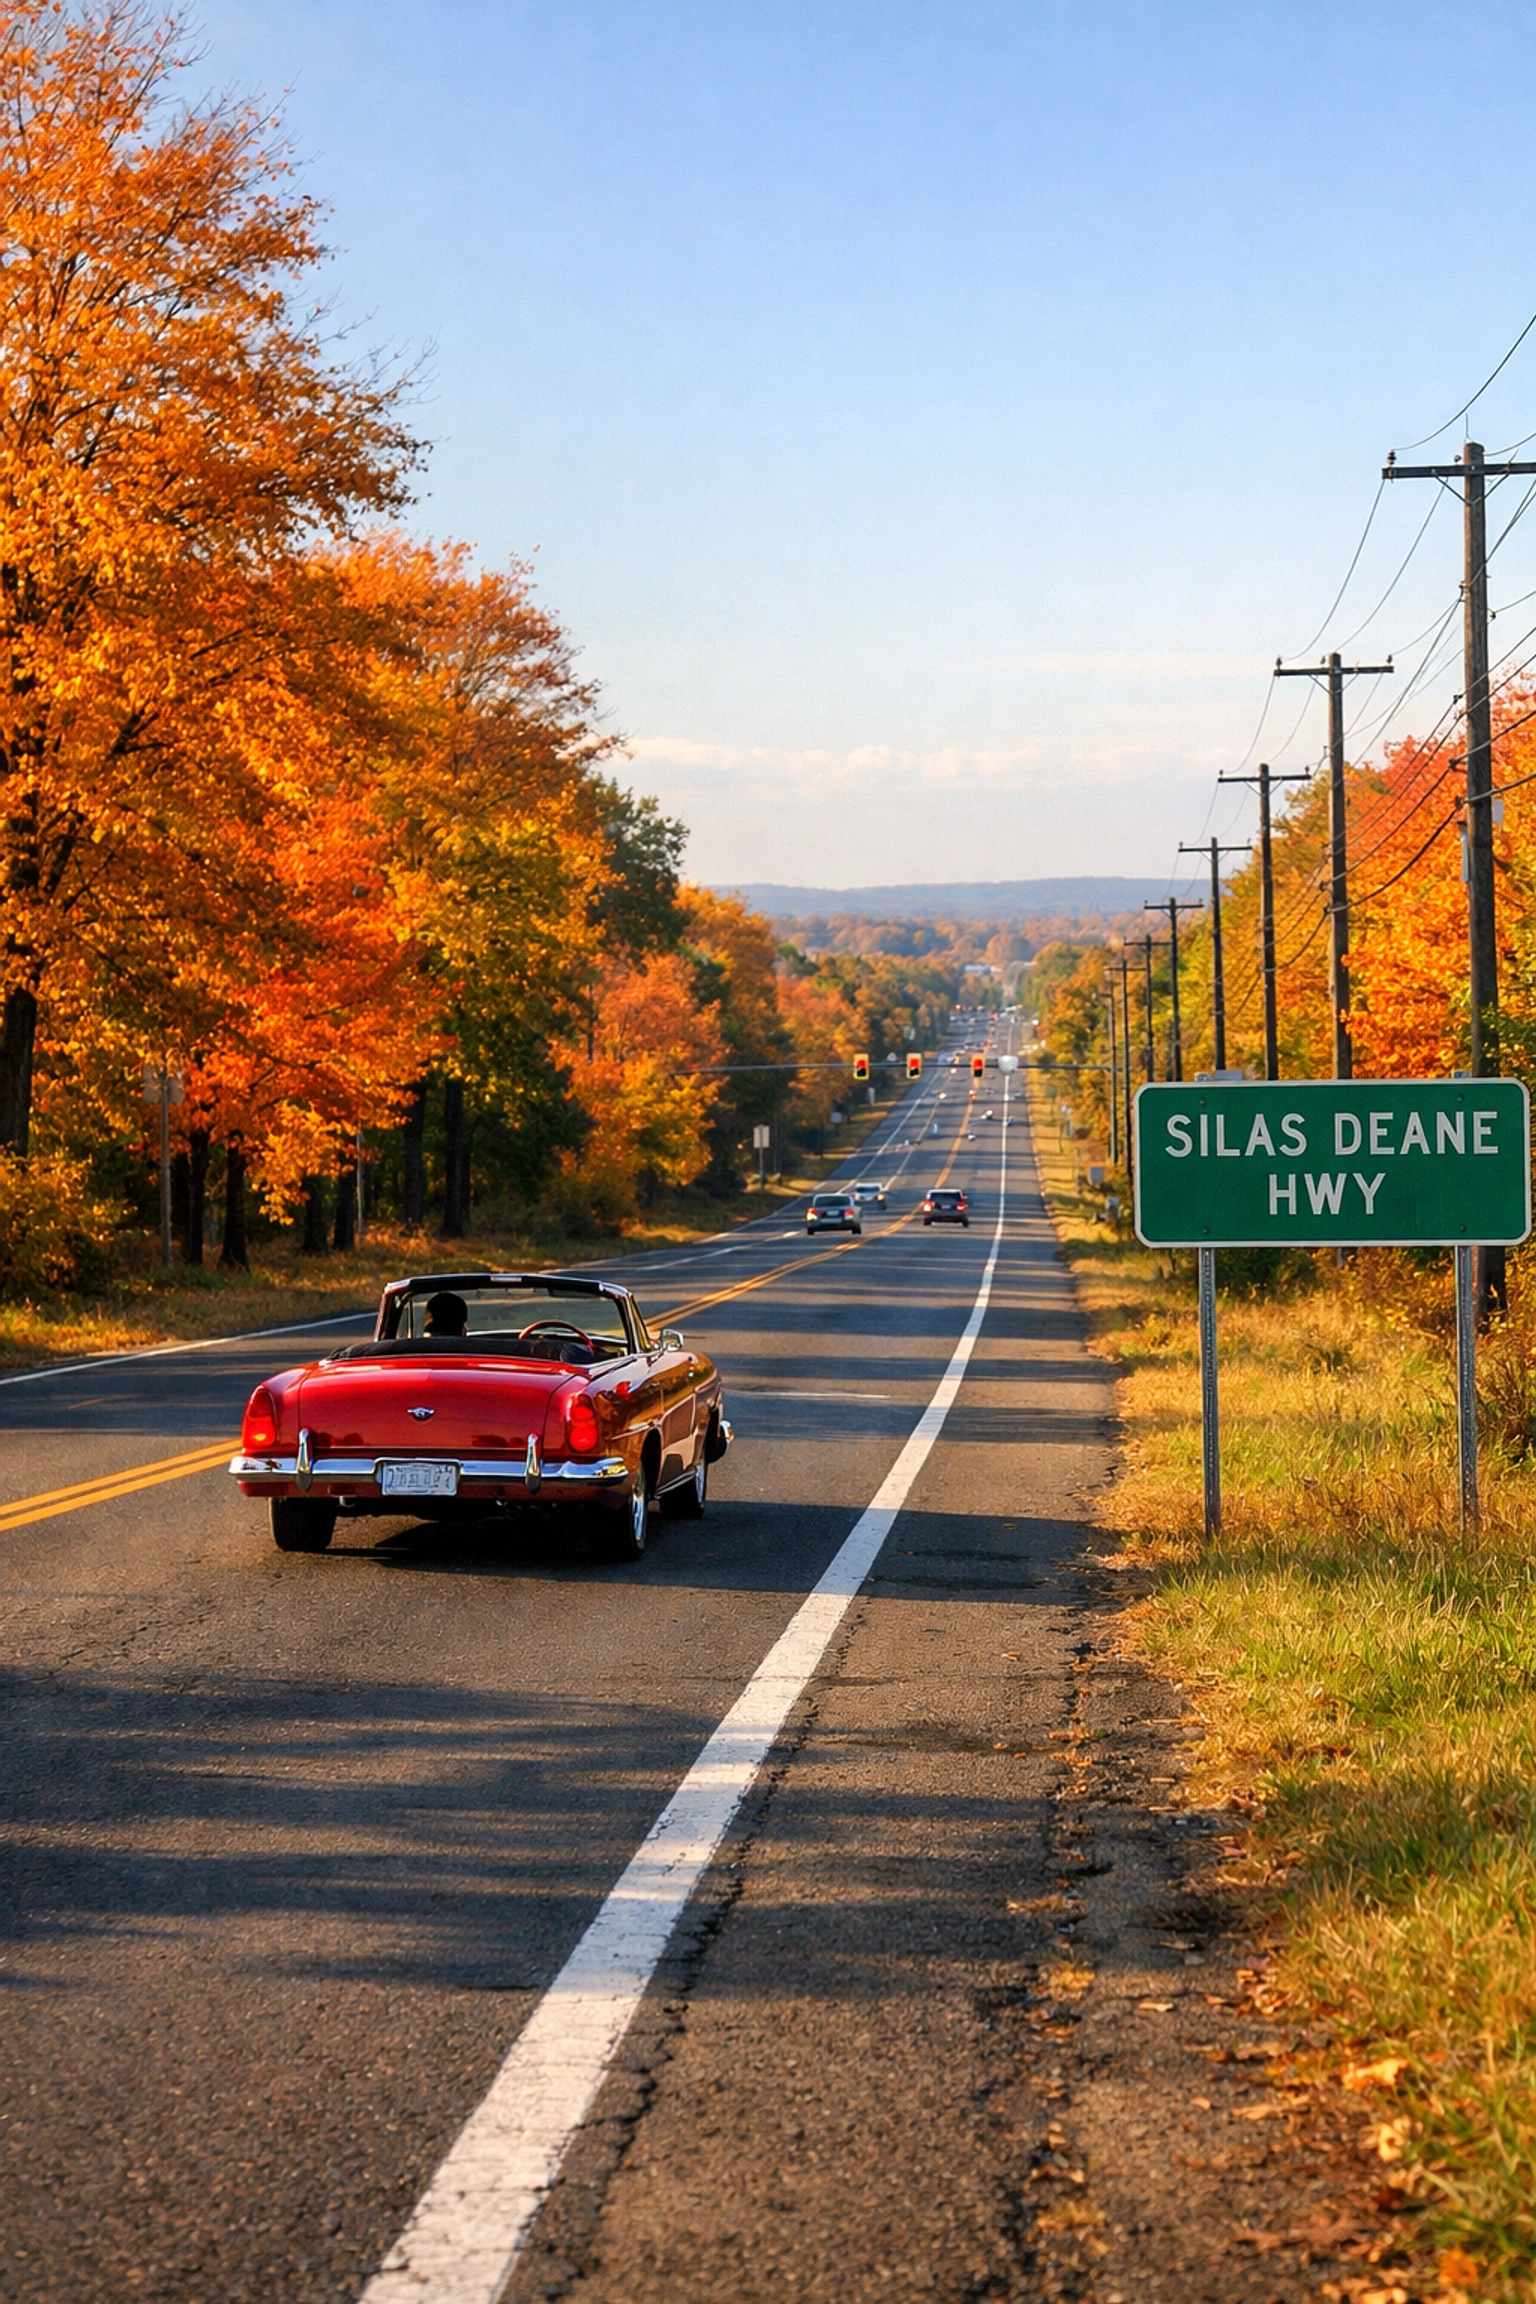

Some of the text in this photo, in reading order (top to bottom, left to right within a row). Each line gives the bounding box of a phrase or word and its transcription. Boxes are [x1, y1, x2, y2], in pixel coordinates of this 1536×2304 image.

[1165, 1111, 1499, 1157] SILAS DEANE
[1269, 1173, 1386, 1214] HWY
